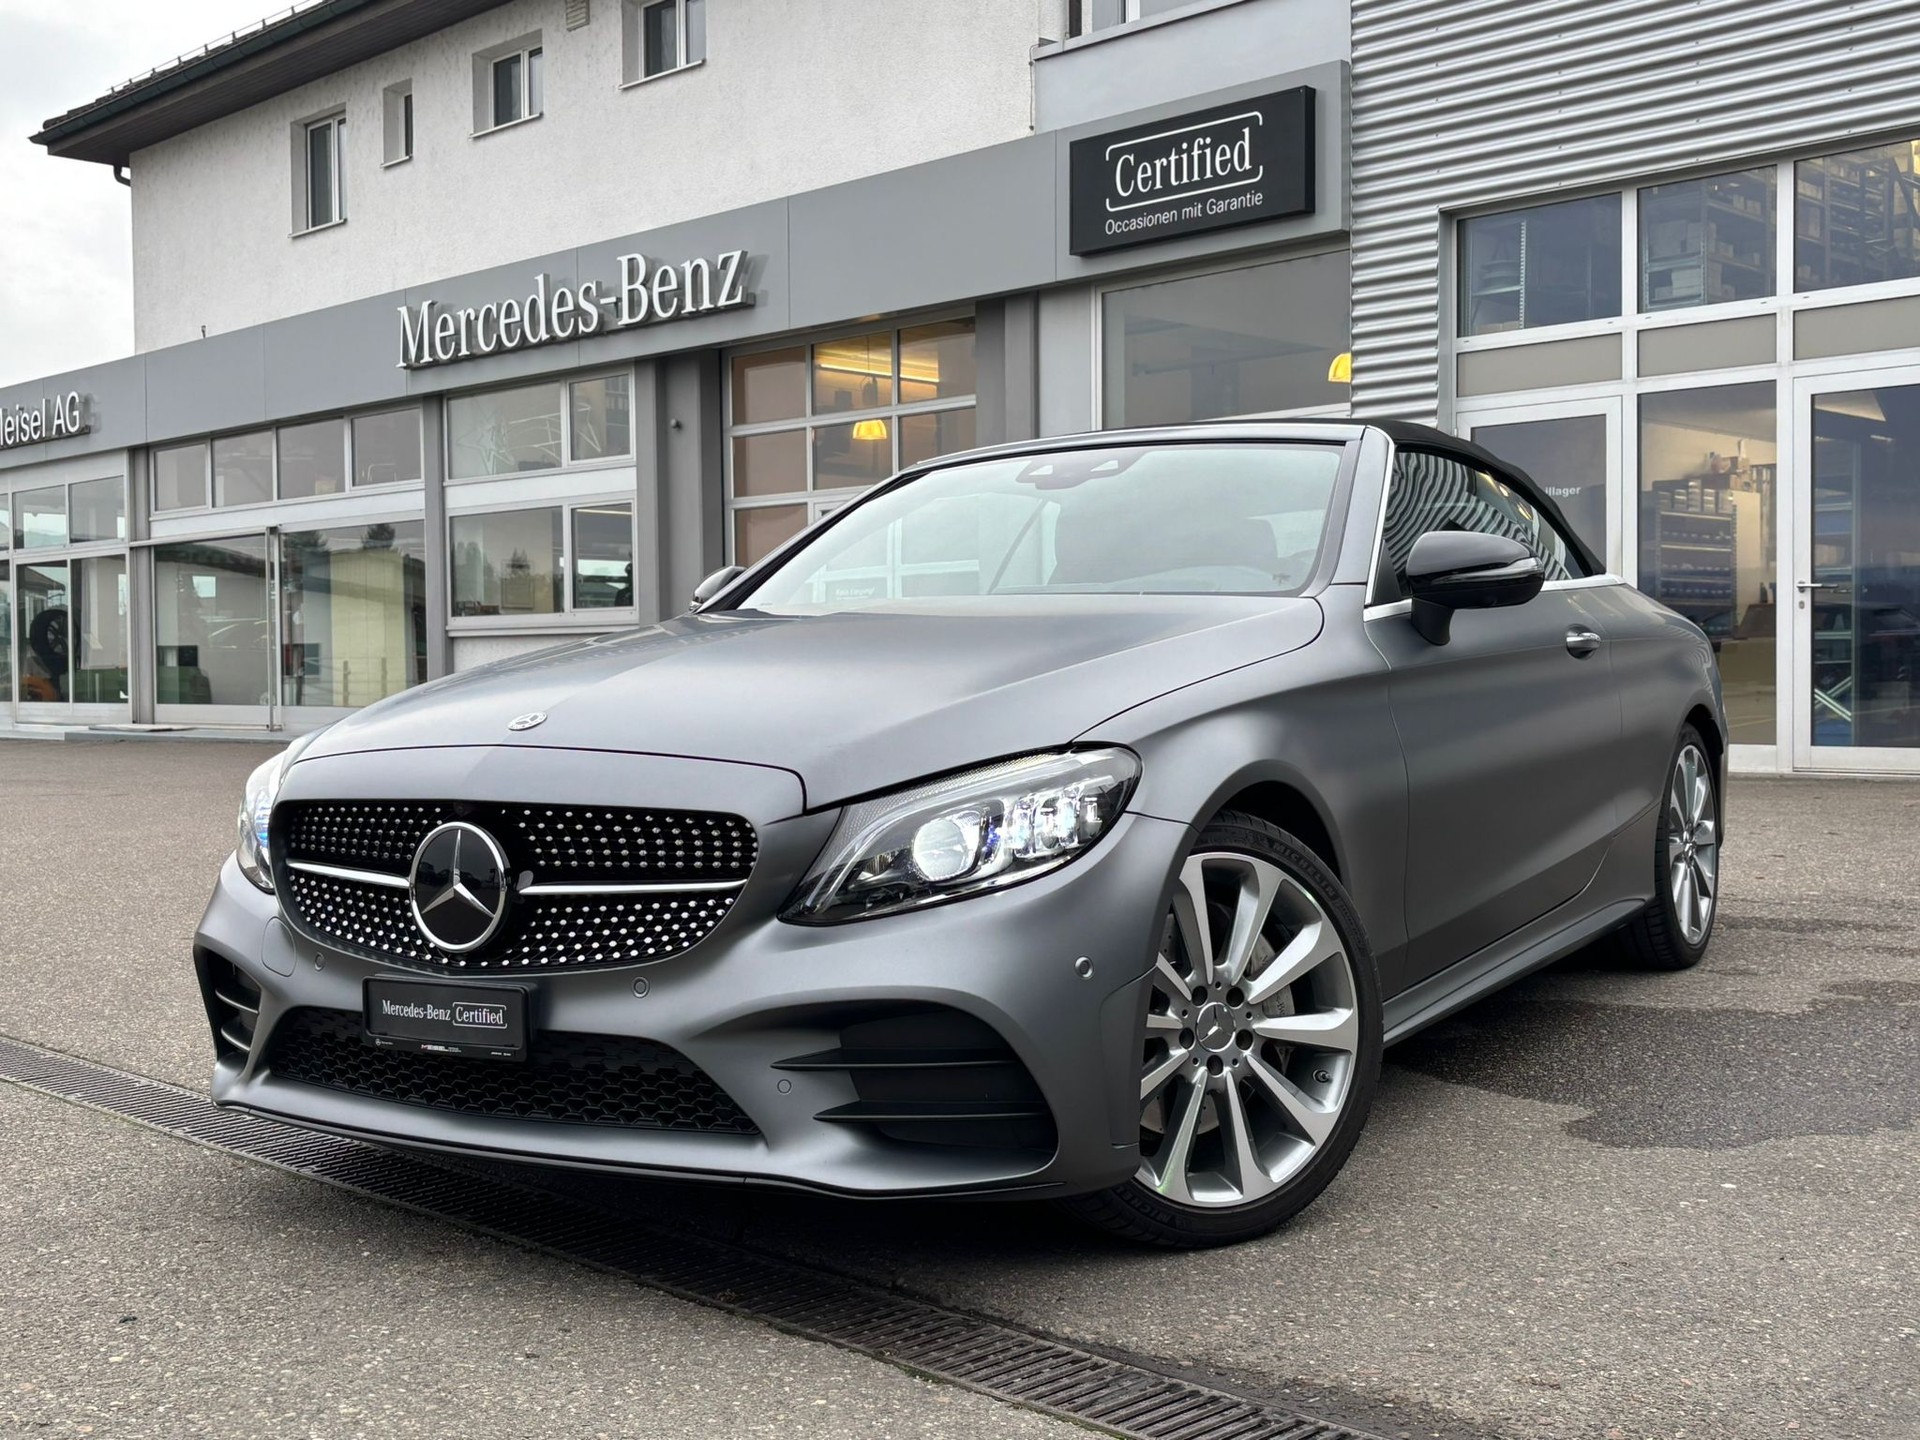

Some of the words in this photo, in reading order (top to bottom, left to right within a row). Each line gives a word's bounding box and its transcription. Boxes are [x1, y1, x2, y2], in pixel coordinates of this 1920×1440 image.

[1115, 127, 1252, 197] Certified
[1105, 207, 1178, 235] Occasionen
[1181, 201, 1203, 221] mit
[1206, 190, 1264, 215] Garantie
[396, 250, 750, 368] Mercedes-Benz
[0, 404, 46, 446] eisel
[52, 391, 80, 433] AG
[1545, 486, 1581, 498] illager
[1273, 841, 1338, 899] MICHELIN
[382, 999, 451, 1021] Mercedes-Benz
[455, 1006, 504, 1025] Certified
